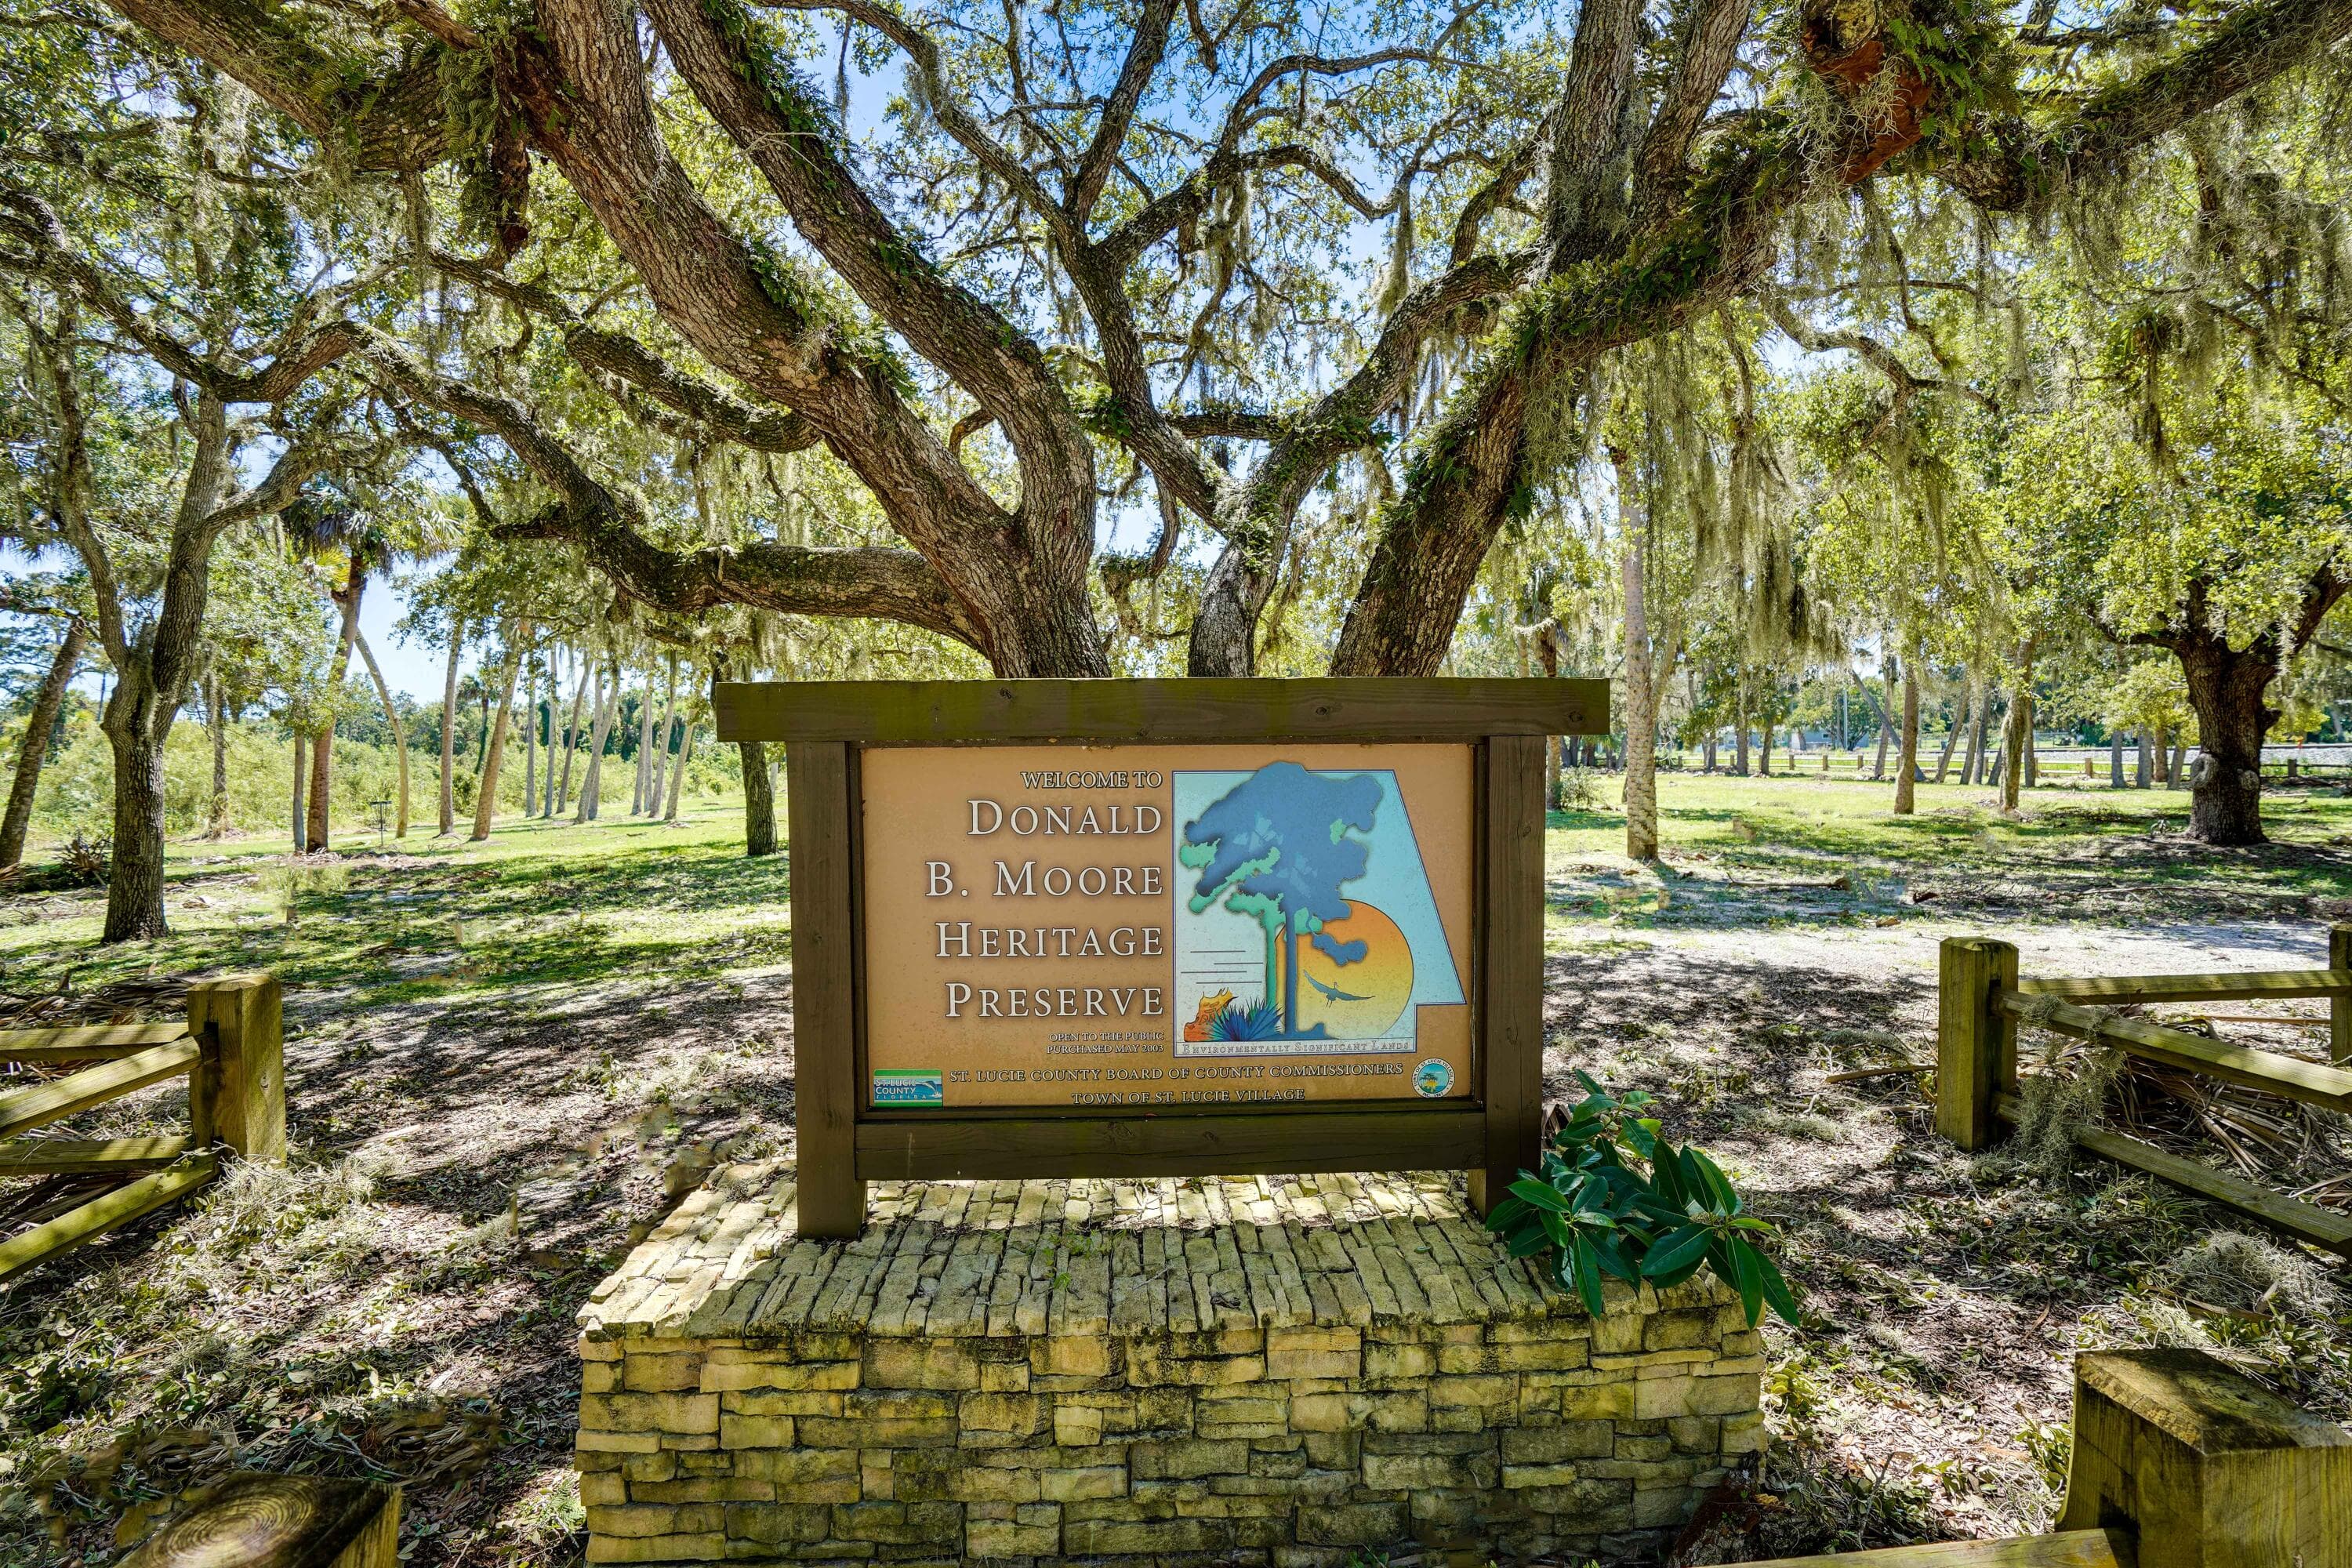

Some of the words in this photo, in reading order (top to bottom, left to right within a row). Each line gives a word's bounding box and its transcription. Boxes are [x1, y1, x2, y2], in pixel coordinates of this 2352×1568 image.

[1021, 771, 1129, 788] WELCOME
[1133, 771, 1163, 787] TO
[967, 799, 1162, 835] DONALD
[925, 861, 969, 896] B.
[993, 860, 1163, 896] MOORE
[935, 922, 1163, 957] HERITAGE
[945, 982, 1164, 1017] PRESERVE
[1049, 1033, 1080, 1041] OPEN
[1082, 1033, 1098, 1041] TO
[1125, 1032, 1164, 1040] PUBLIC
[1047, 1044, 1112, 1054] PURCHASED
[1115, 1044, 1139, 1053] MAY
[1142, 1044, 1163, 1053] 2003
[1181, 1044, 1290, 1054] ENVIRONMENTALLY
[1294, 1041, 1367, 1052] SIGNIFICANT
[1372, 1040, 1410, 1051] LANDS
[949, 1070, 971, 1082] ST.
[977, 1070, 1025, 1081] LUCIE
[1030, 1069, 1101, 1081] COUNTY
[1106, 1069, 1163, 1080] BOARD
[1168, 1068, 1190, 1080] OF
[1194, 1066, 1265, 1079] COUNTY
[1269, 1063, 1403, 1077] COMMISSIONERS
[1072, 1092, 1123, 1105] TOWN
[1128, 1092, 1150, 1103] OF
[1154, 1091, 1176, 1103] ST.
[1181, 1091, 1229, 1102] LUCIE
[1236, 1089, 1305, 1101] VILLAGE
